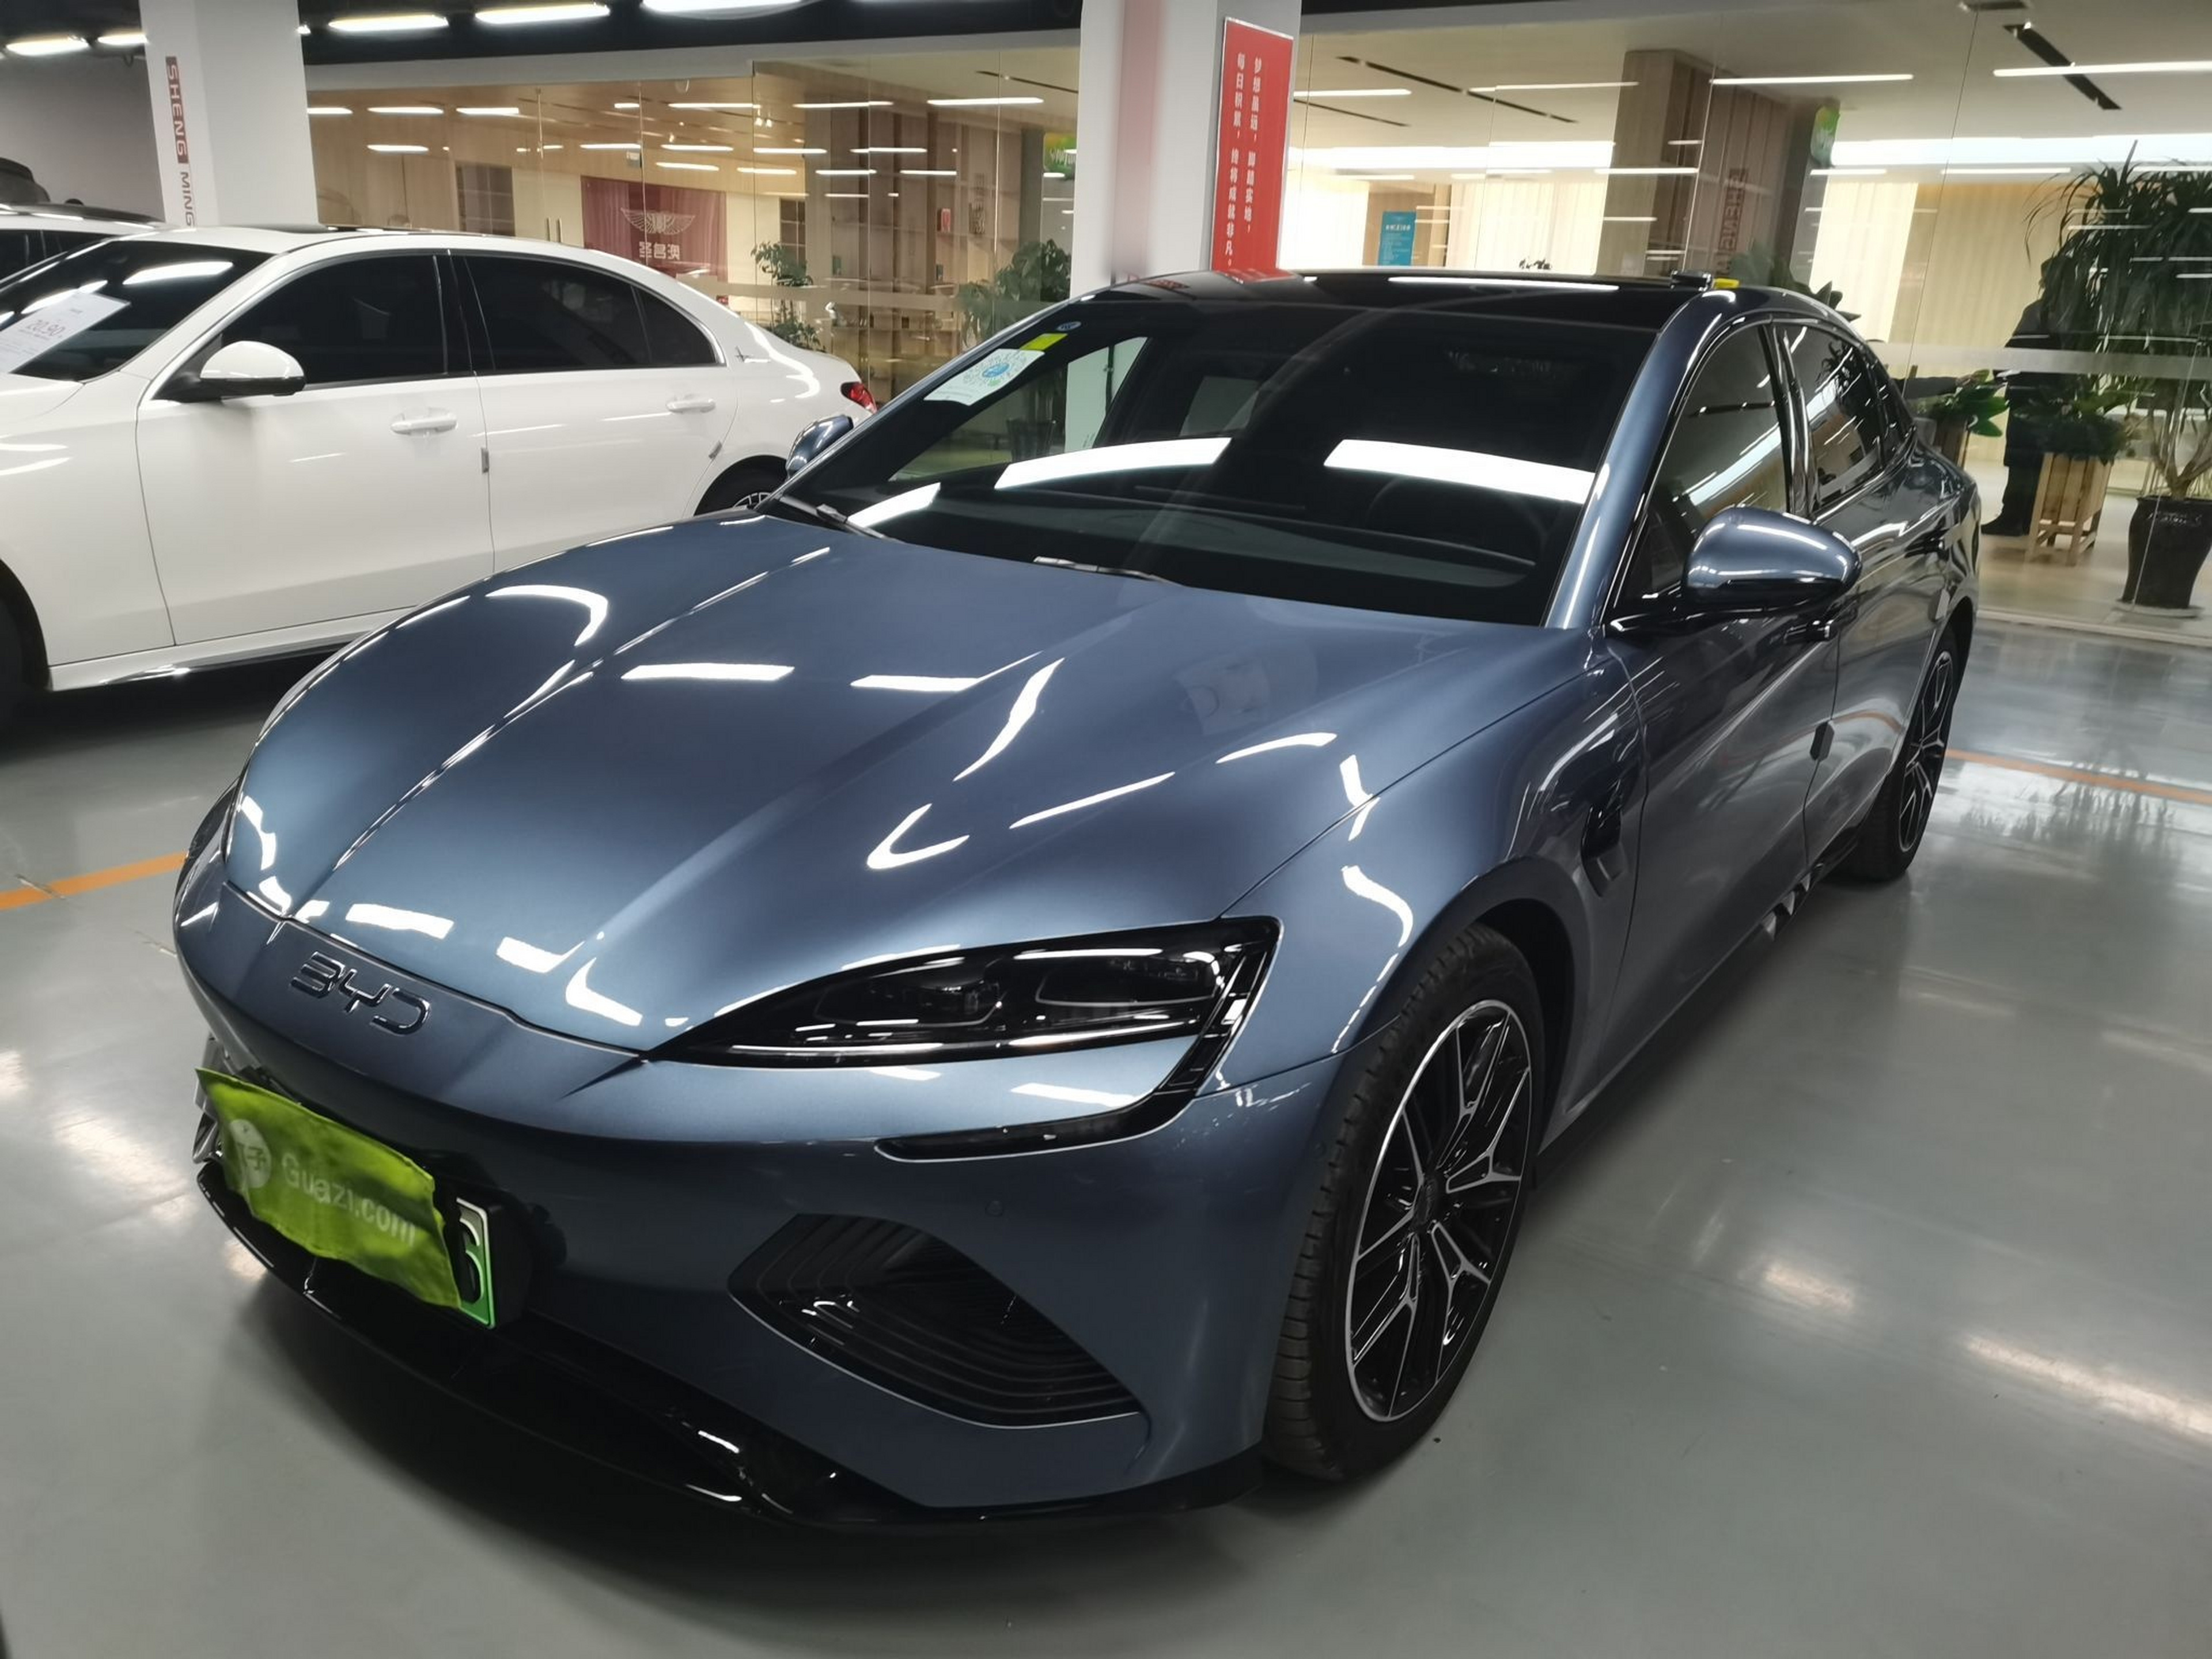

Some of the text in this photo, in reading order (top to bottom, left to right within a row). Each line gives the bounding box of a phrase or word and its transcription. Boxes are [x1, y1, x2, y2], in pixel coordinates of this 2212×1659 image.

[169, 64, 195, 228] SHENG MING
[290, 951, 429, 1035] BYD
[281, 1152, 416, 1248] Guazi.com
